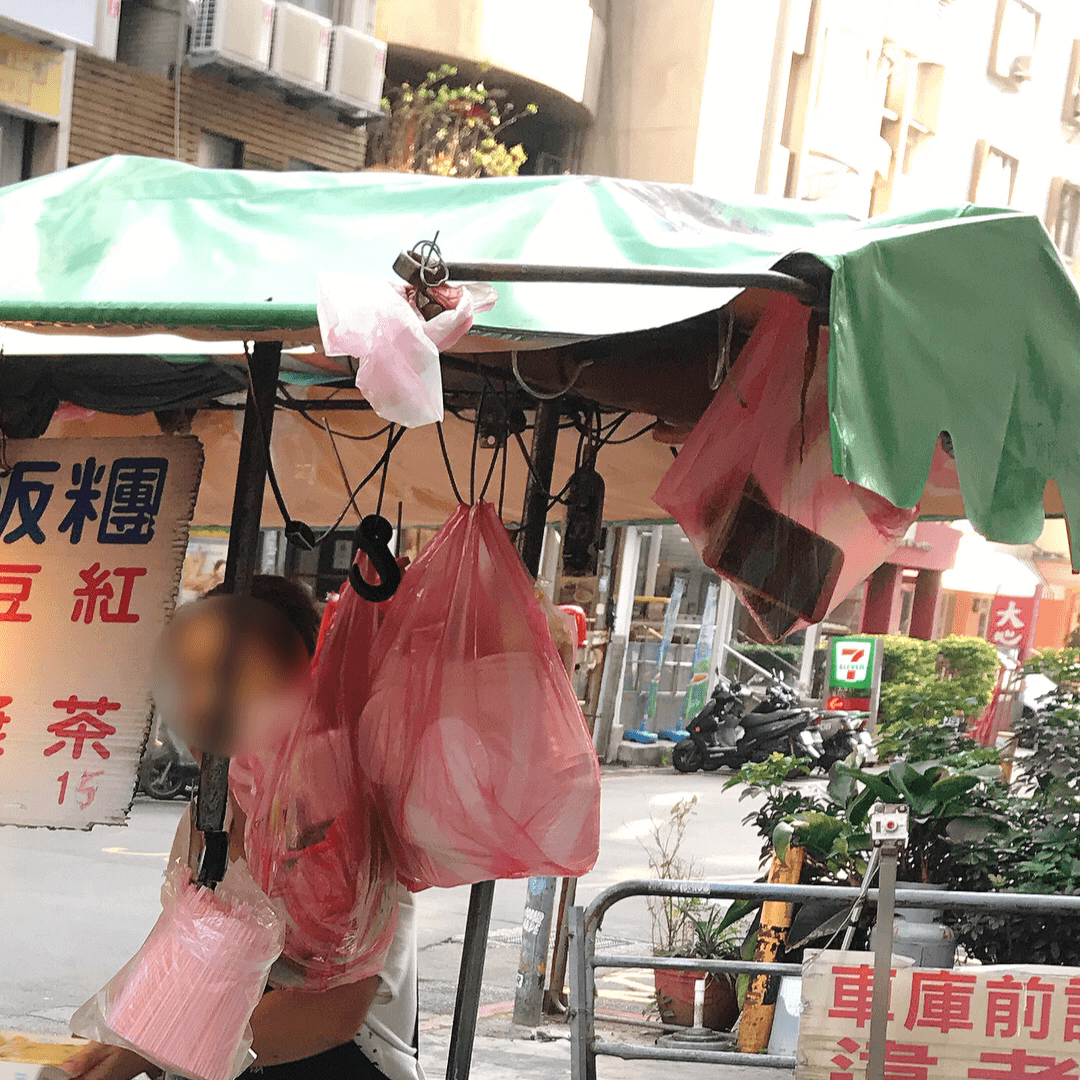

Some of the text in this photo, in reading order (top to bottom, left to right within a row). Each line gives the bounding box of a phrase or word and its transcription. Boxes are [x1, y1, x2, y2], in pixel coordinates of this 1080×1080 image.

[43, 561, 148, 760] 紅茶
[57, 770, 105, 811] 15
[828, 964, 1080, 1043] 車庫前
